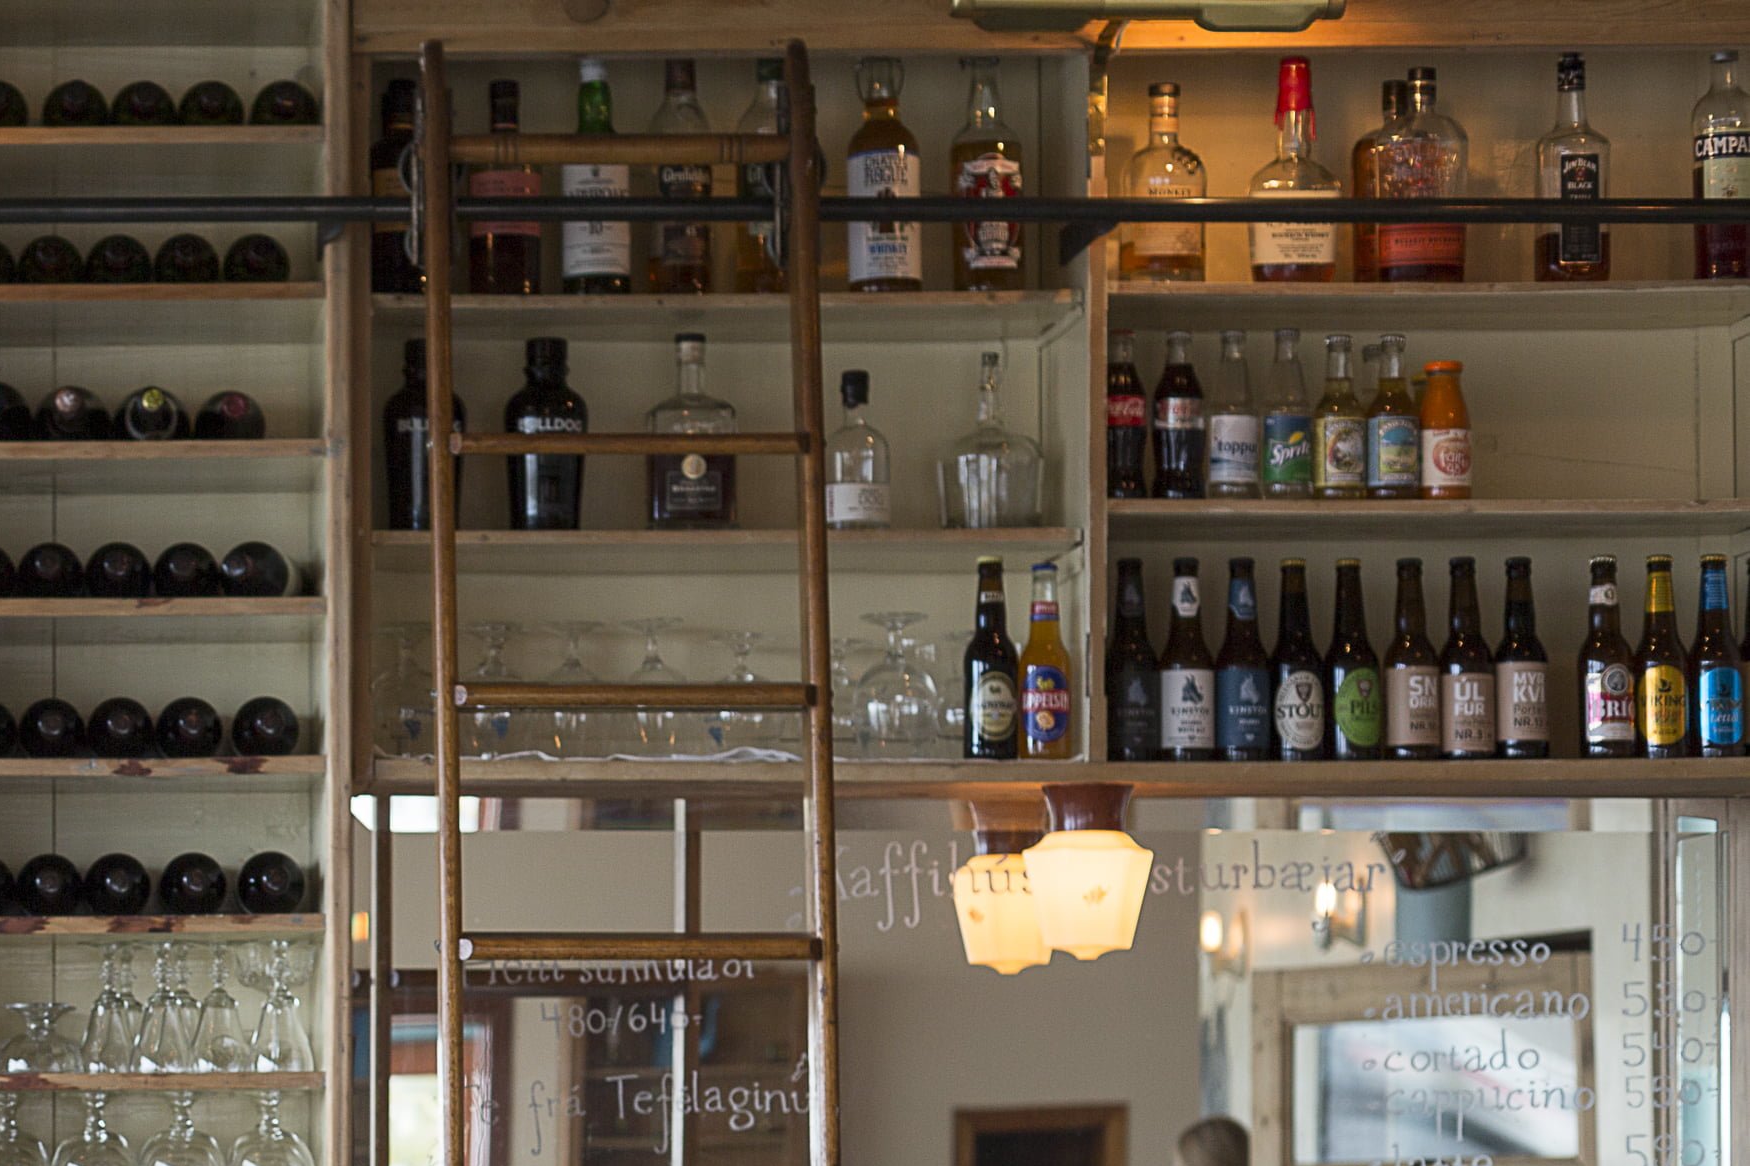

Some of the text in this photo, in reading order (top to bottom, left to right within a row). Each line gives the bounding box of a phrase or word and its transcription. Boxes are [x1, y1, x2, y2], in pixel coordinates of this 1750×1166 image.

[1695, 133, 1750, 158] CAMPA
[517, 417, 583, 432] BULLDOG
[1217, 440, 1257, 456] toppu
[1455, 677, 1485, 701] ÚL
[1455, 702, 1485, 716] FUR
[1383, 938, 1551, 992] espresso
[1382, 983, 1592, 1022] americano
[1383, 1029, 1540, 1073] cortado
[1385, 1080, 1596, 1143] cappucino
